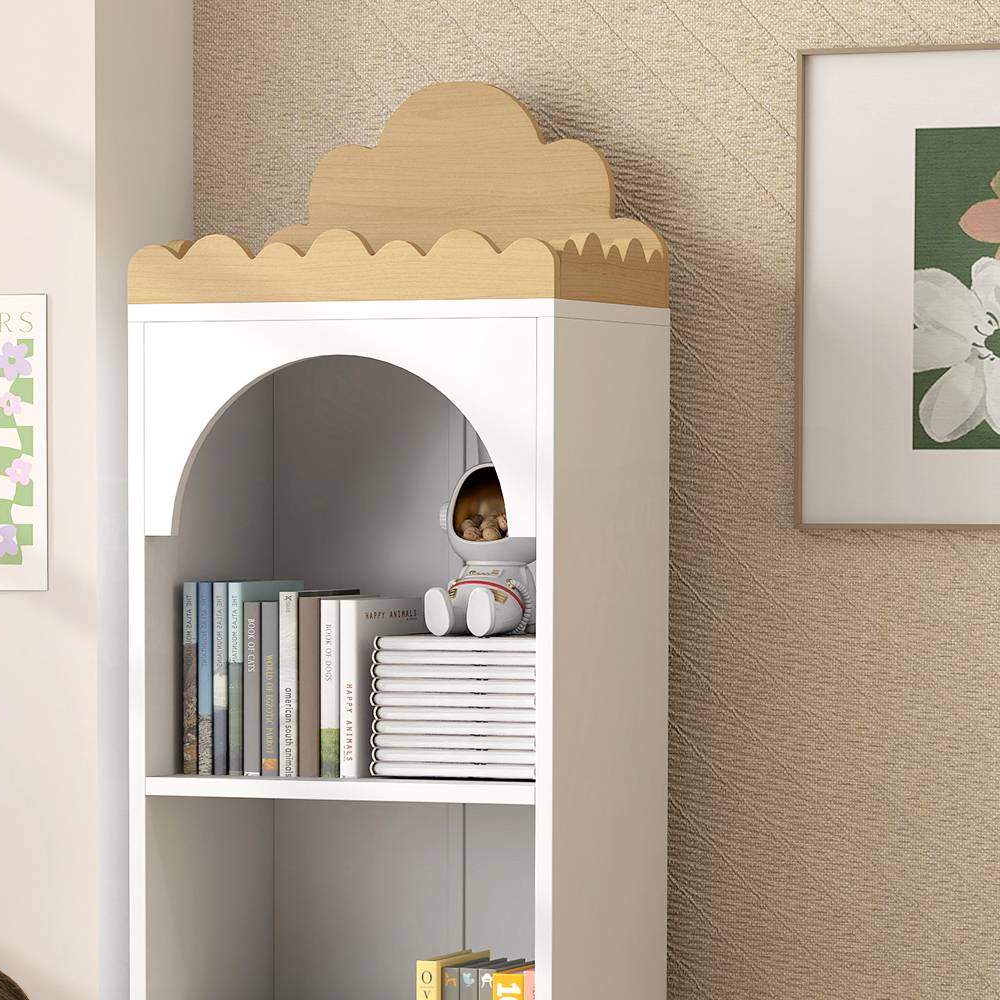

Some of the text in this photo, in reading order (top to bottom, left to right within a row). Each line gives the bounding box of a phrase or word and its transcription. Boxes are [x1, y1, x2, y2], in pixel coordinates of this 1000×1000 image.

[365, 609, 417, 620] HAPPY ANIMALS
[247, 618, 256, 673] BOOK OF CATS
[325, 624, 333, 682] BOOK OF DOGS
[285, 687, 293, 777] american south animals
